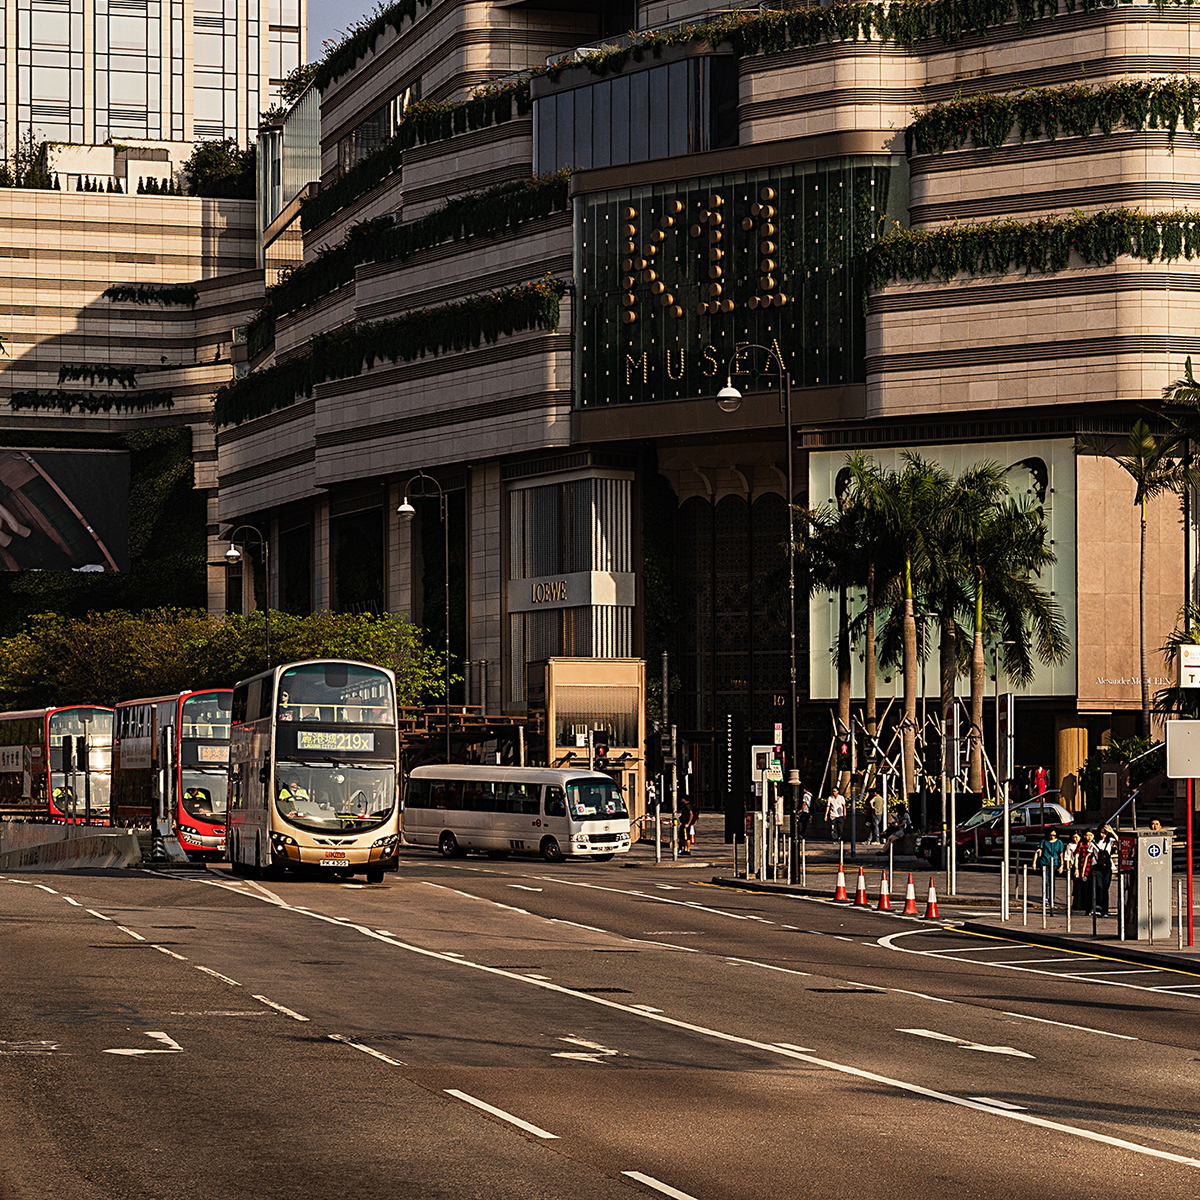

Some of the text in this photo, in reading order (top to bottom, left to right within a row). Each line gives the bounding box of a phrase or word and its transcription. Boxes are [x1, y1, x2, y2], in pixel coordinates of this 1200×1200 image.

[622, 186, 790, 325] K11
[625, 338, 786, 386] MUSEA
[531, 580, 568, 603] LOEWE
